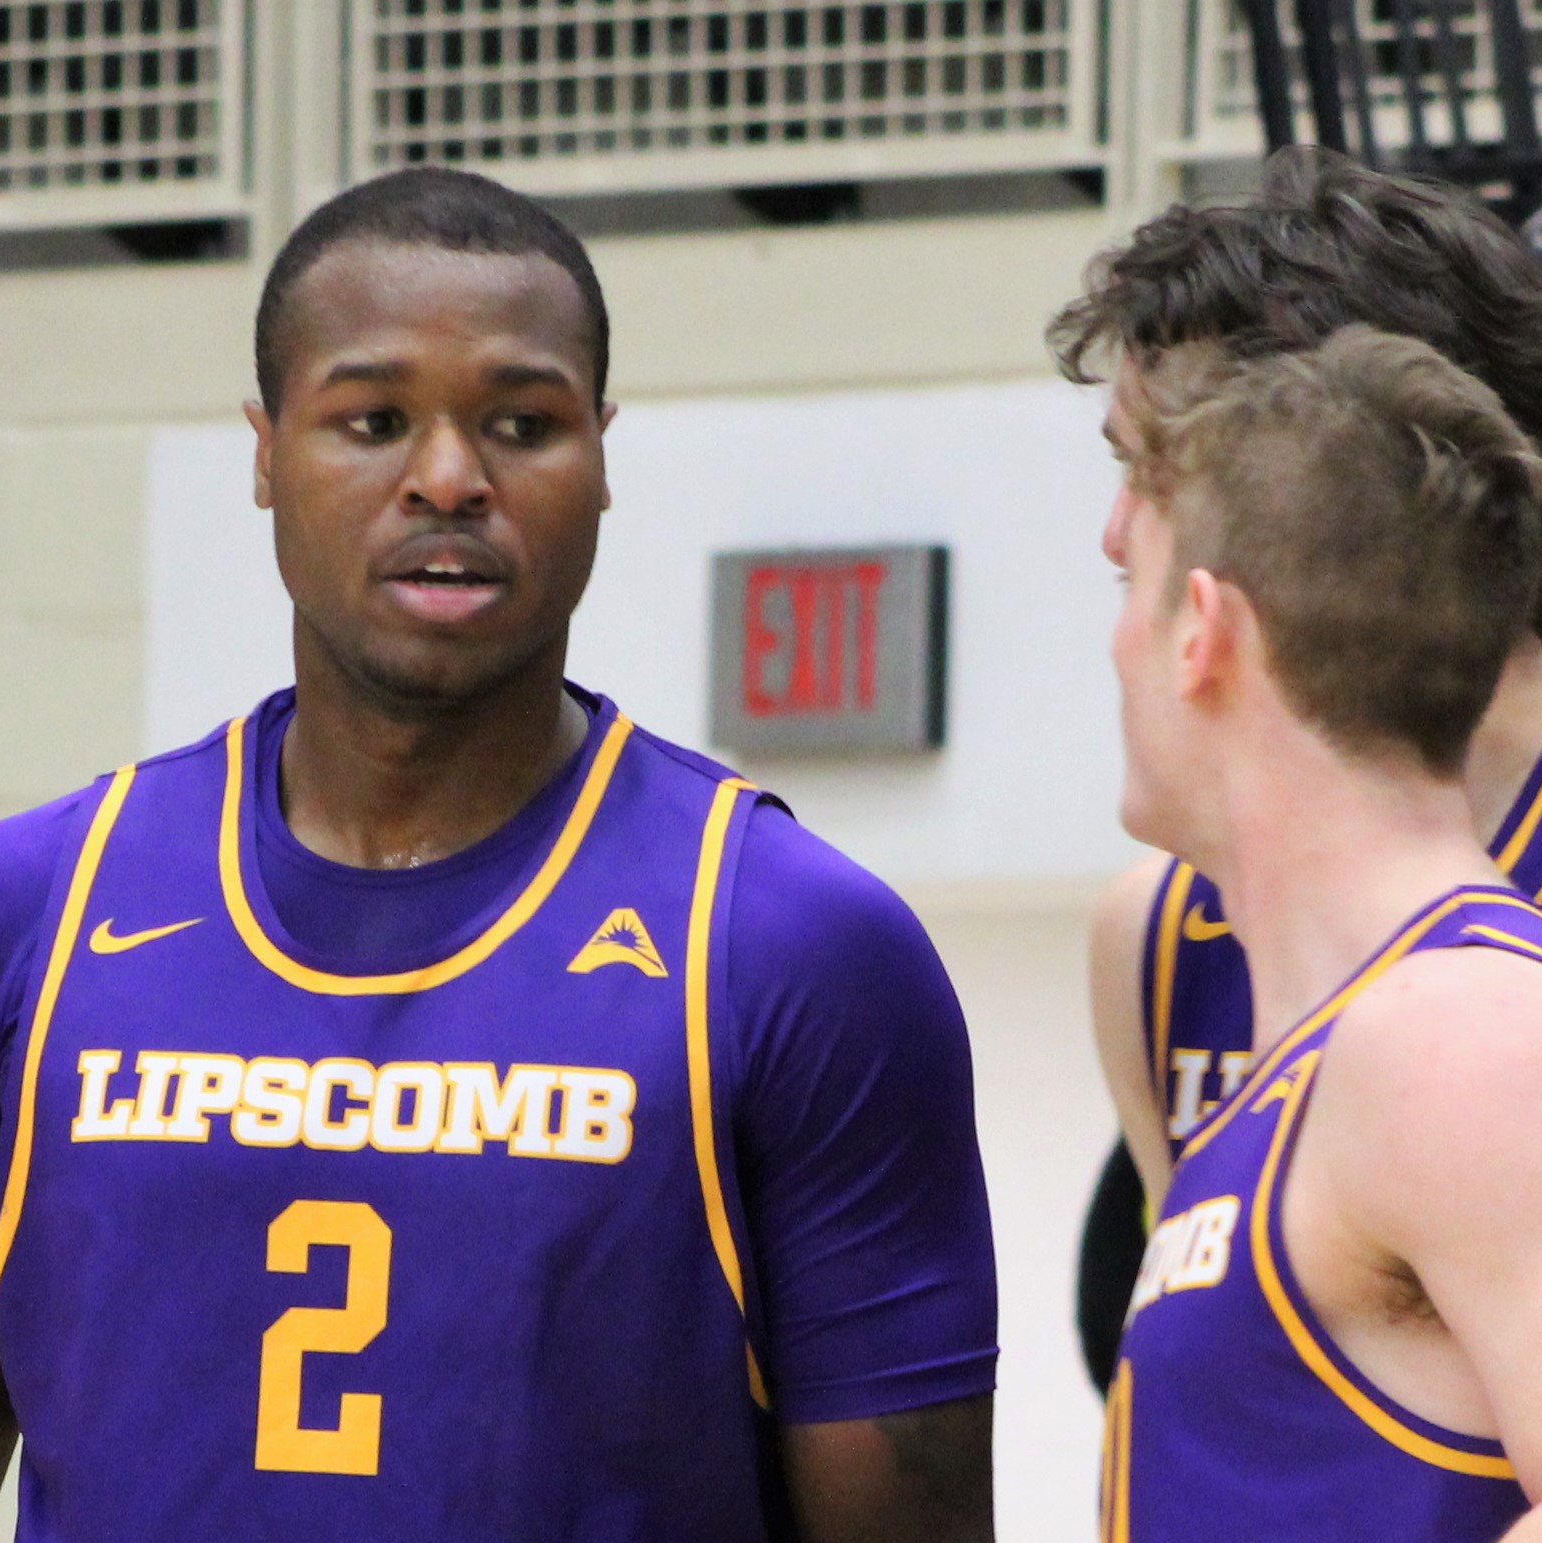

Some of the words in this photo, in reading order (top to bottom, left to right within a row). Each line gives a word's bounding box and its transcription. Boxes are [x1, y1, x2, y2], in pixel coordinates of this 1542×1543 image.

[743, 563, 884, 716] EXIT
[71, 1049, 637, 1165] LIPSCOMB
[254, 1200, 393, 1475] 2
